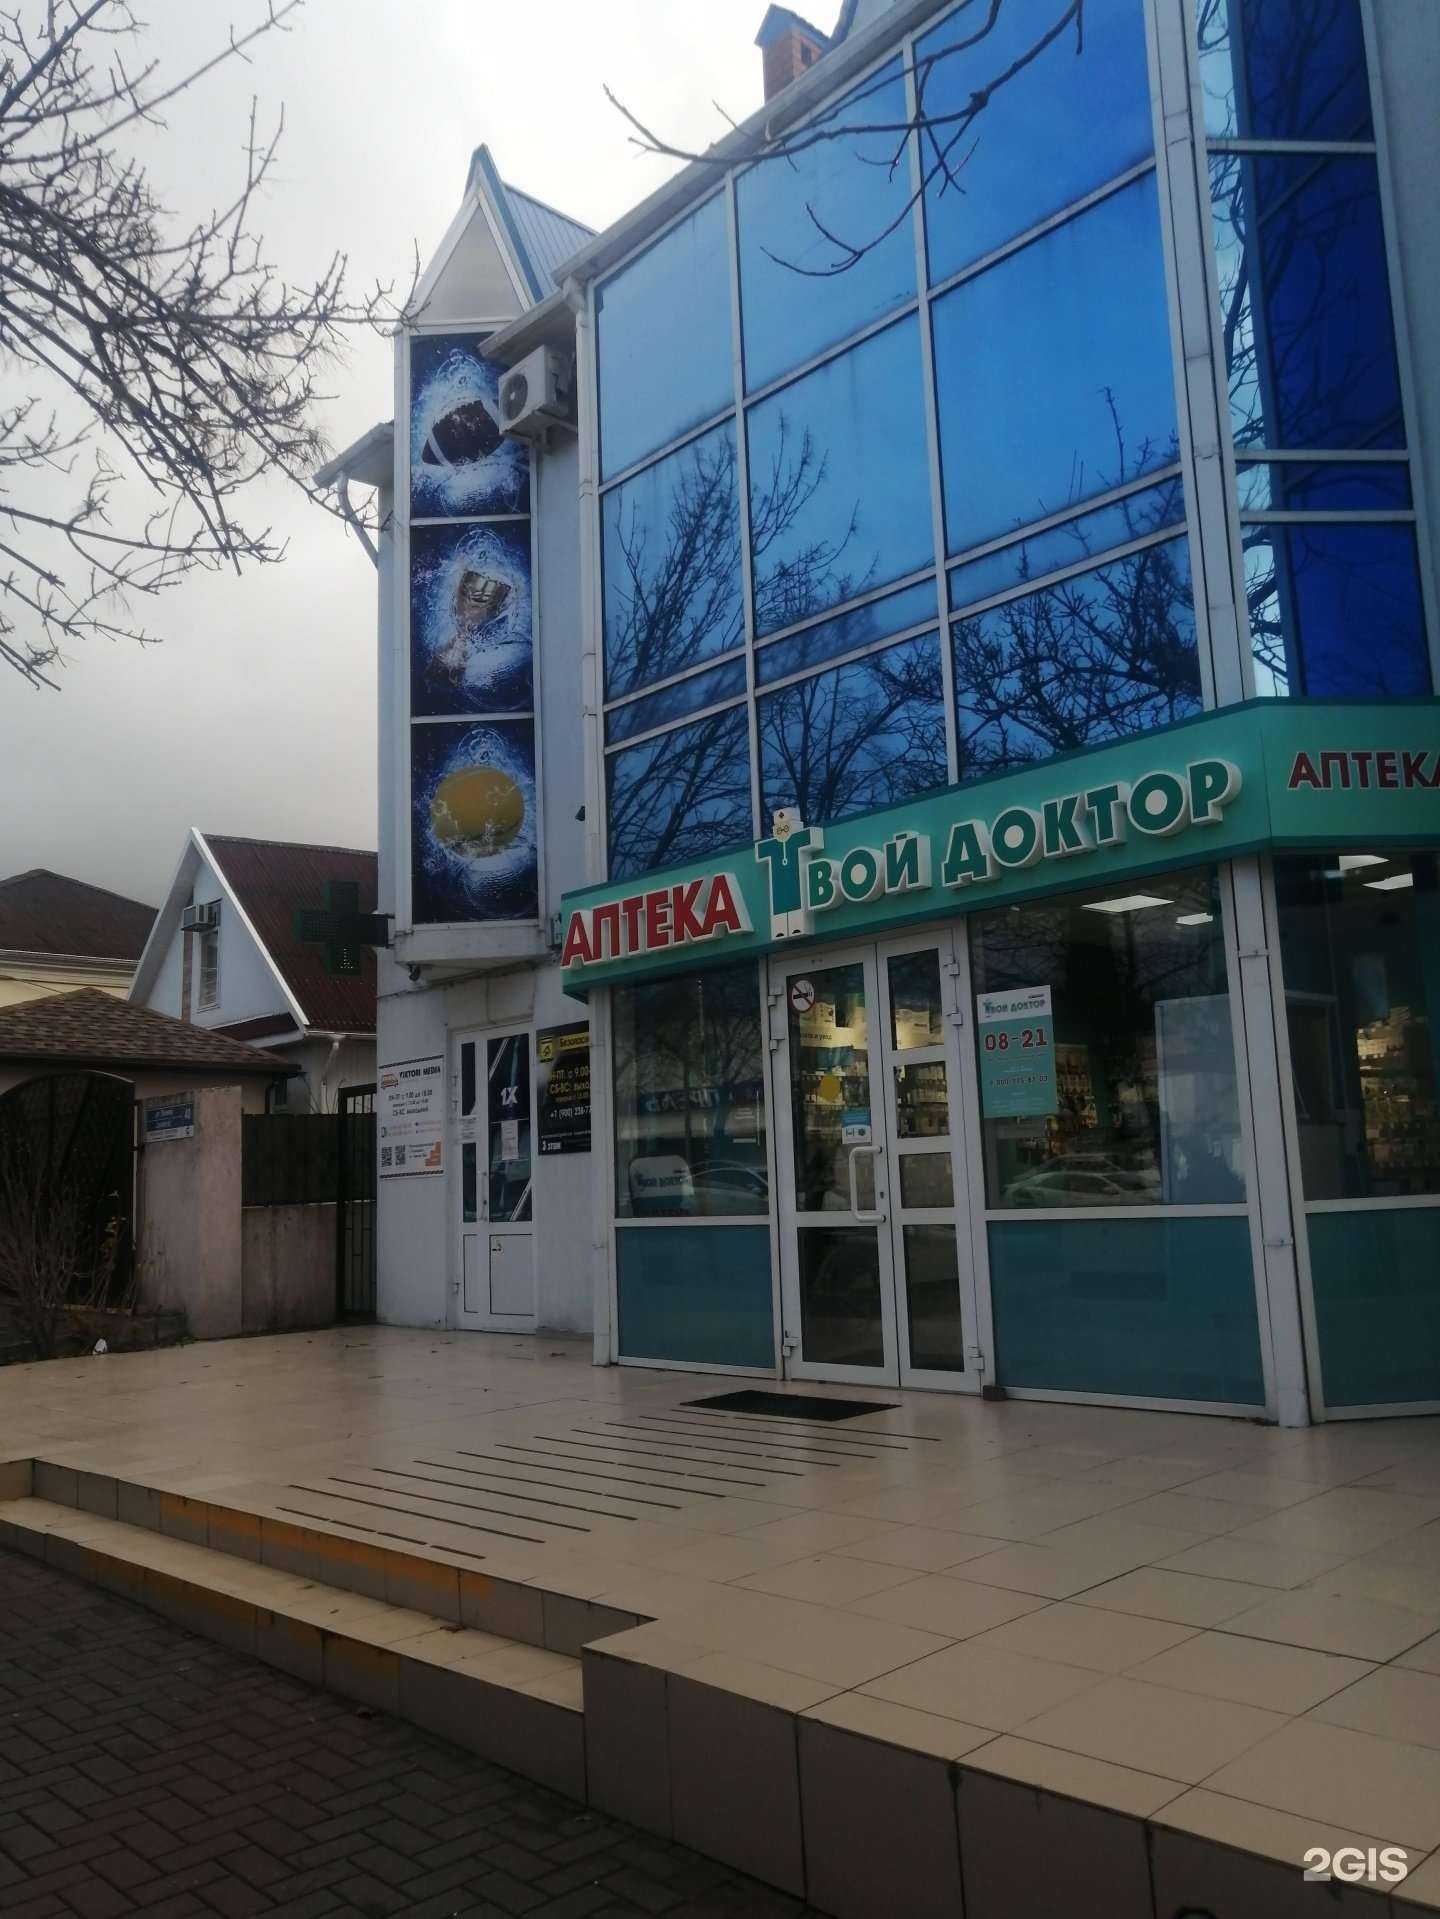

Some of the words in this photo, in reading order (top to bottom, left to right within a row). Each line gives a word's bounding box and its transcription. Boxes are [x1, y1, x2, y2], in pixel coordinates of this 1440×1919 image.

[1288, 751, 1440, 789] АПТЕК
[942, 758, 1242, 887] ДОКТОР
[561, 872, 751, 968] АПТЕКА
